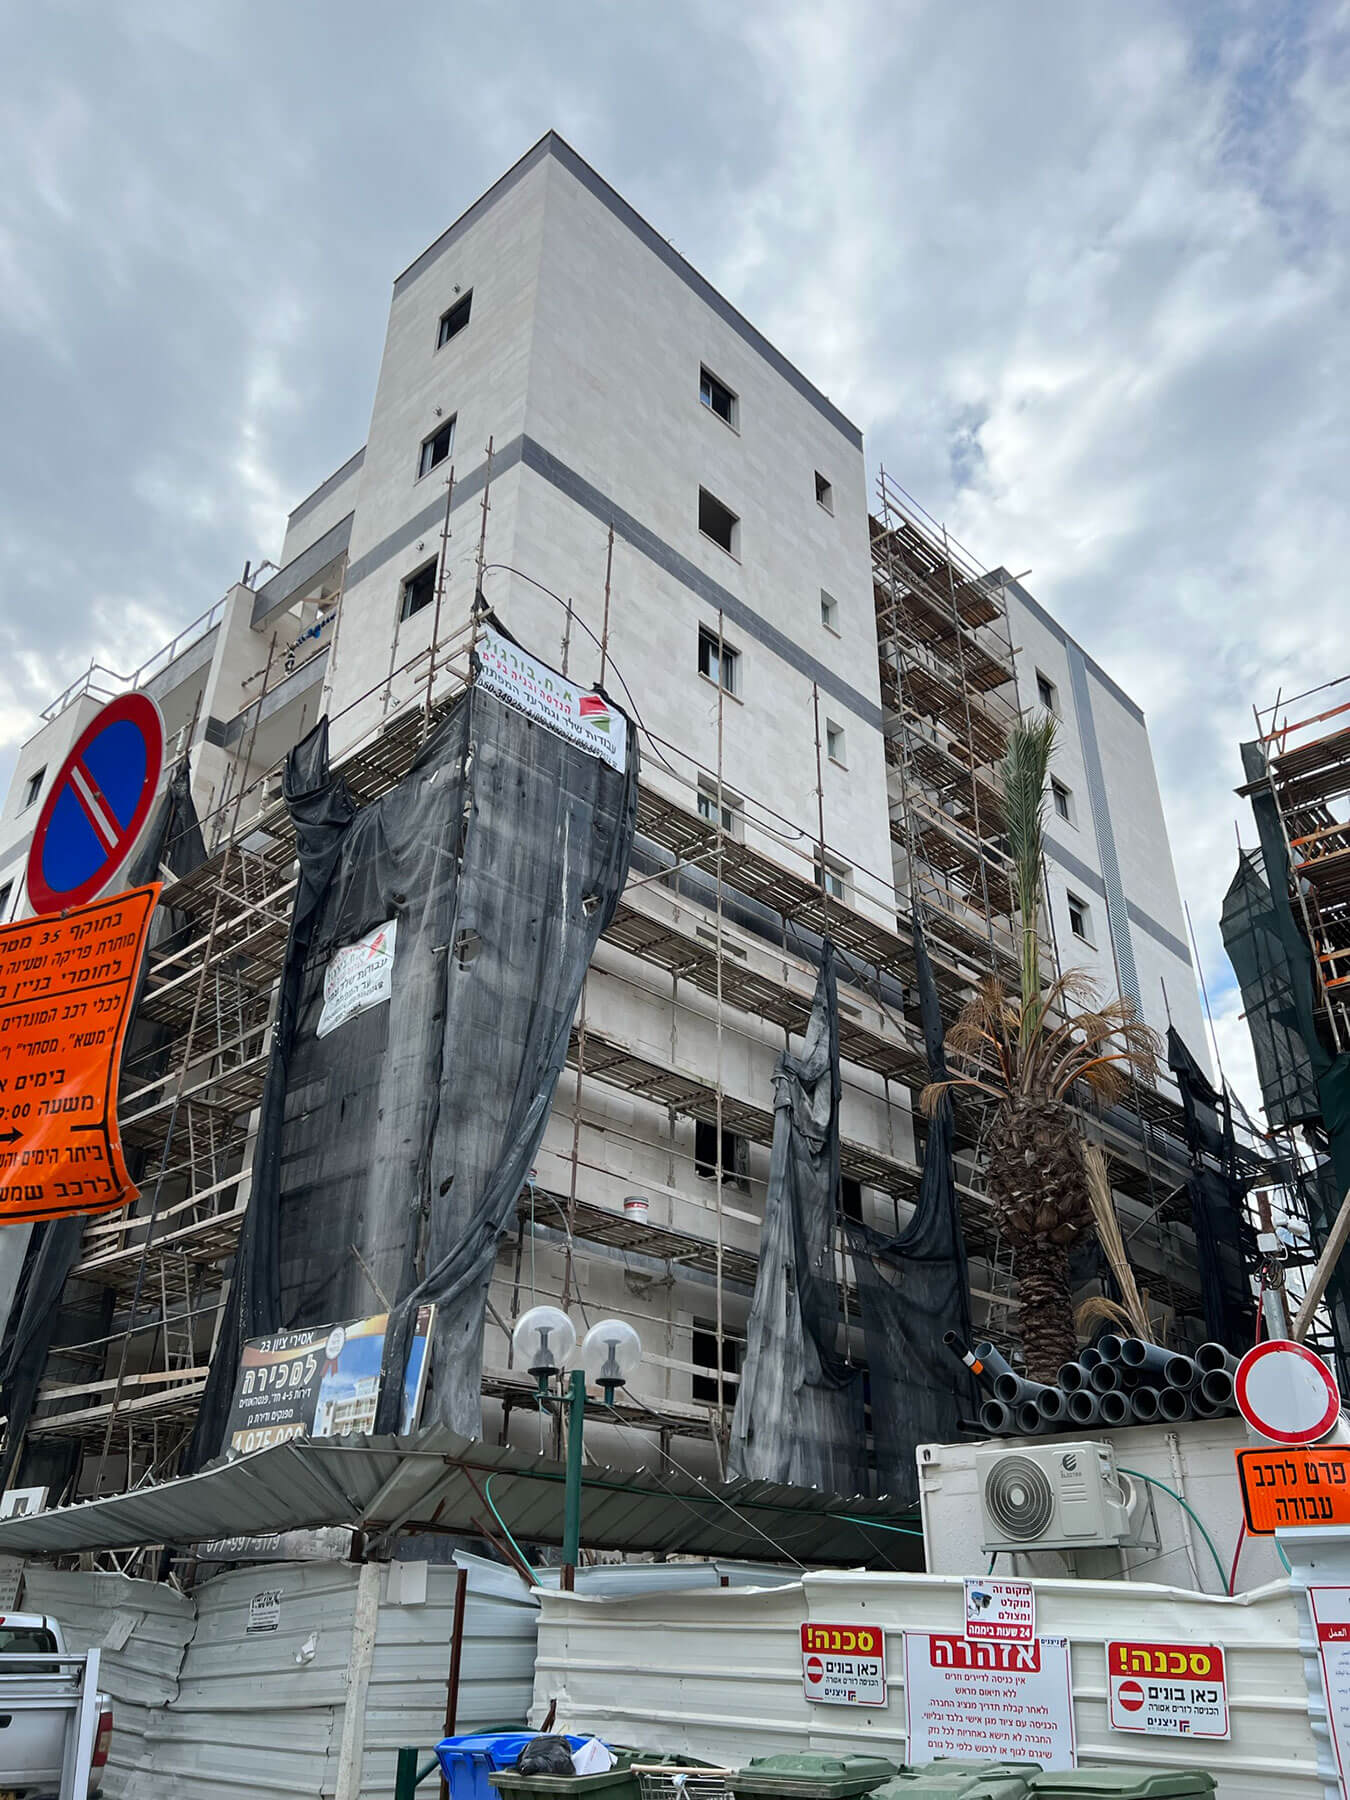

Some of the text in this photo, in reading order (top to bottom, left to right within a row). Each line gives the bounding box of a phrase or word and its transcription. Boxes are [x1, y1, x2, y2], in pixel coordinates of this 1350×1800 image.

[40, 929, 62, 946] 35
[95, 932, 136, 956] מותרת
[51, 945, 92, 968] פריקה
[61, 959, 122, 984] לחומרי
[13, 976, 51, 999] בניין
[61, 1002, 88, 1020] רכב
[93, 994, 121, 1013] לכלי
[14, 1069, 66, 1091] בימים
[37, 1094, 95, 1116] משעה
[21, 1148, 59, 1167] הימים
[65, 1145, 104, 1164] ביתר
[53, 1175, 113, 1198] לרכב
[272, 1336, 288, 1354] ציון
[290, 1331, 314, 1347] אסירי
[259, 1340, 271, 1354] 23
[241, 1353, 317, 1395] למכירה
[1253, 1459, 1347, 1487] פרט לרכב
[1275, 1496, 1333, 1520] עבודה
[992, 1585, 1030, 1597] מקום זה
[1000, 1598, 1030, 1609] מוקלט
[998, 1610, 1030, 1621] ומצולם
[968, 1624, 1030, 1637] 24 שעות ביממה
[807, 1628, 874, 1652] סכנה!
[933, 1639, 1036, 1669] אזהרה
[1119, 1647, 1211, 1676] סכנה!
[826, 1662, 878, 1677] כאן בונים
[842, 1676, 858, 1686] לזרים
[859, 1677, 879, 1687] הכניסה
[992, 1675, 1013, 1685] כניסה
[1015, 1676, 1026, 1686] אין
[824, 1687, 847, 1696] ניצנים
[955, 1686, 1017, 1698] ללא תיאום מראש
[1148, 1686, 1218, 1704] כאן בונים
[979, 1701, 1000, 1711] תדריך
[1003, 1703, 1023, 1714] קבלת
[1026, 1706, 1049, 1715] ולאחר
[1148, 1703, 1219, 1716] הכניסה לזרים אסורה
[946, 1713, 963, 1723] בלבד
[965, 1715, 982, 1724] אישי
[984, 1717, 997, 1726] מגן
[999, 1718, 1013, 1727] ציוד
[1015, 1719, 1027, 1728] עם
[1029, 1720, 1057, 1730] הכניסה
[1147, 1717, 1177, 1727] ניצנים
[928, 1725, 1052, 1744] החברה לא תישא באחריות לכל נזק
[928, 1739, 1052, 1759] שיגרם לגוף או לרכוש כלפי כל גורם
